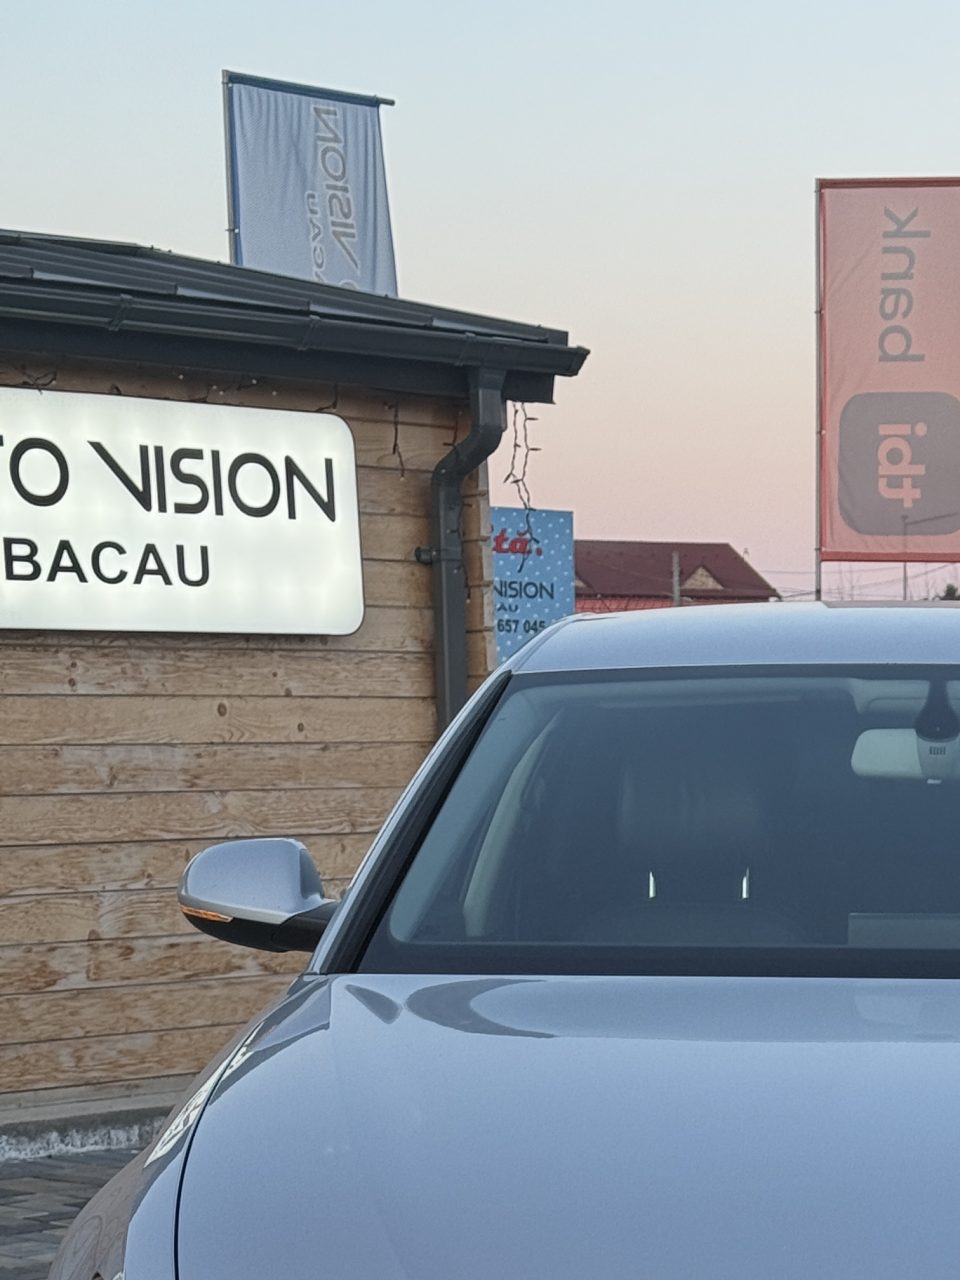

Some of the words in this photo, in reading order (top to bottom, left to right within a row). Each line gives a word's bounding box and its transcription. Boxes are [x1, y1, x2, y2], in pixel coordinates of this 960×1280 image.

[0, 434, 70, 507] O
[88, 440, 336, 523] VISION
[3, 536, 210, 587] BACAU
[497, 619, 519, 633] 657
